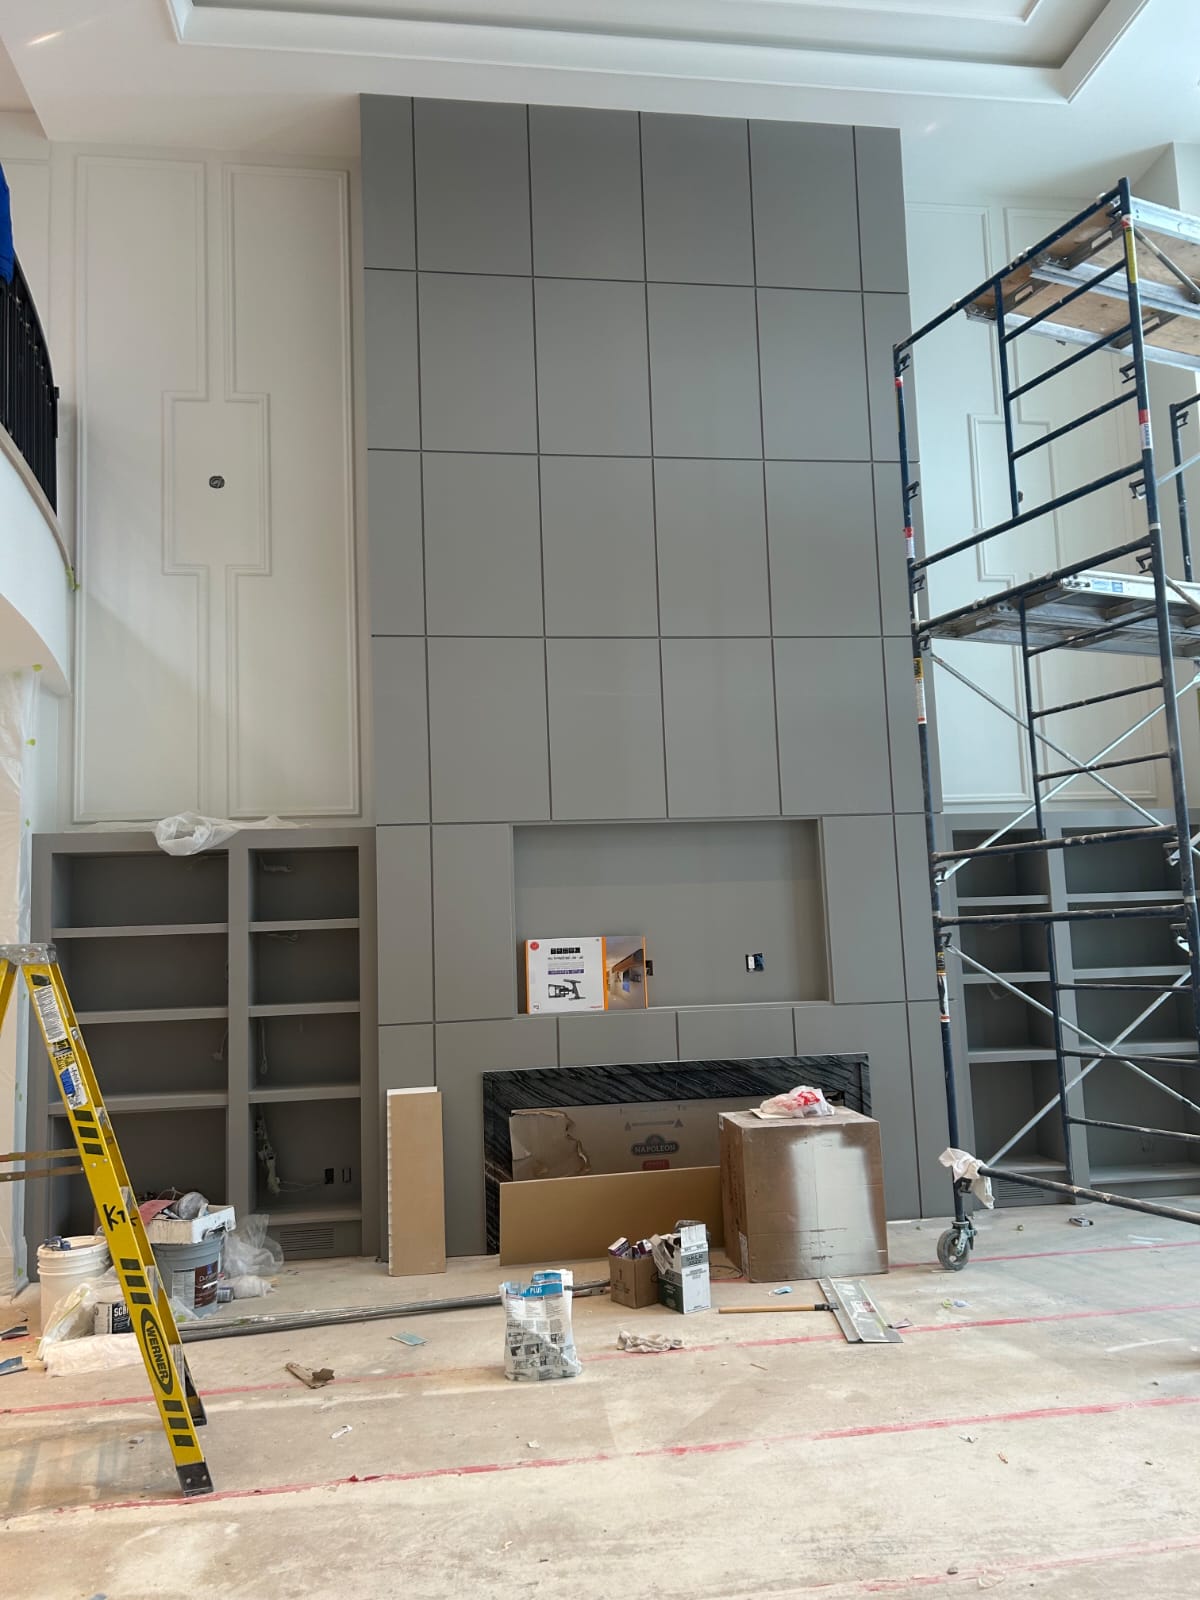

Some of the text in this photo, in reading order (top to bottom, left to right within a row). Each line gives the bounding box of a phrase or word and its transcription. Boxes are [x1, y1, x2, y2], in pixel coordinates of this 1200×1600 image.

[634, 1143, 676, 1154] NAPOLEON
[530, 1286, 543, 1295] PLUS
[146, 1326, 170, 1382] WERNER
